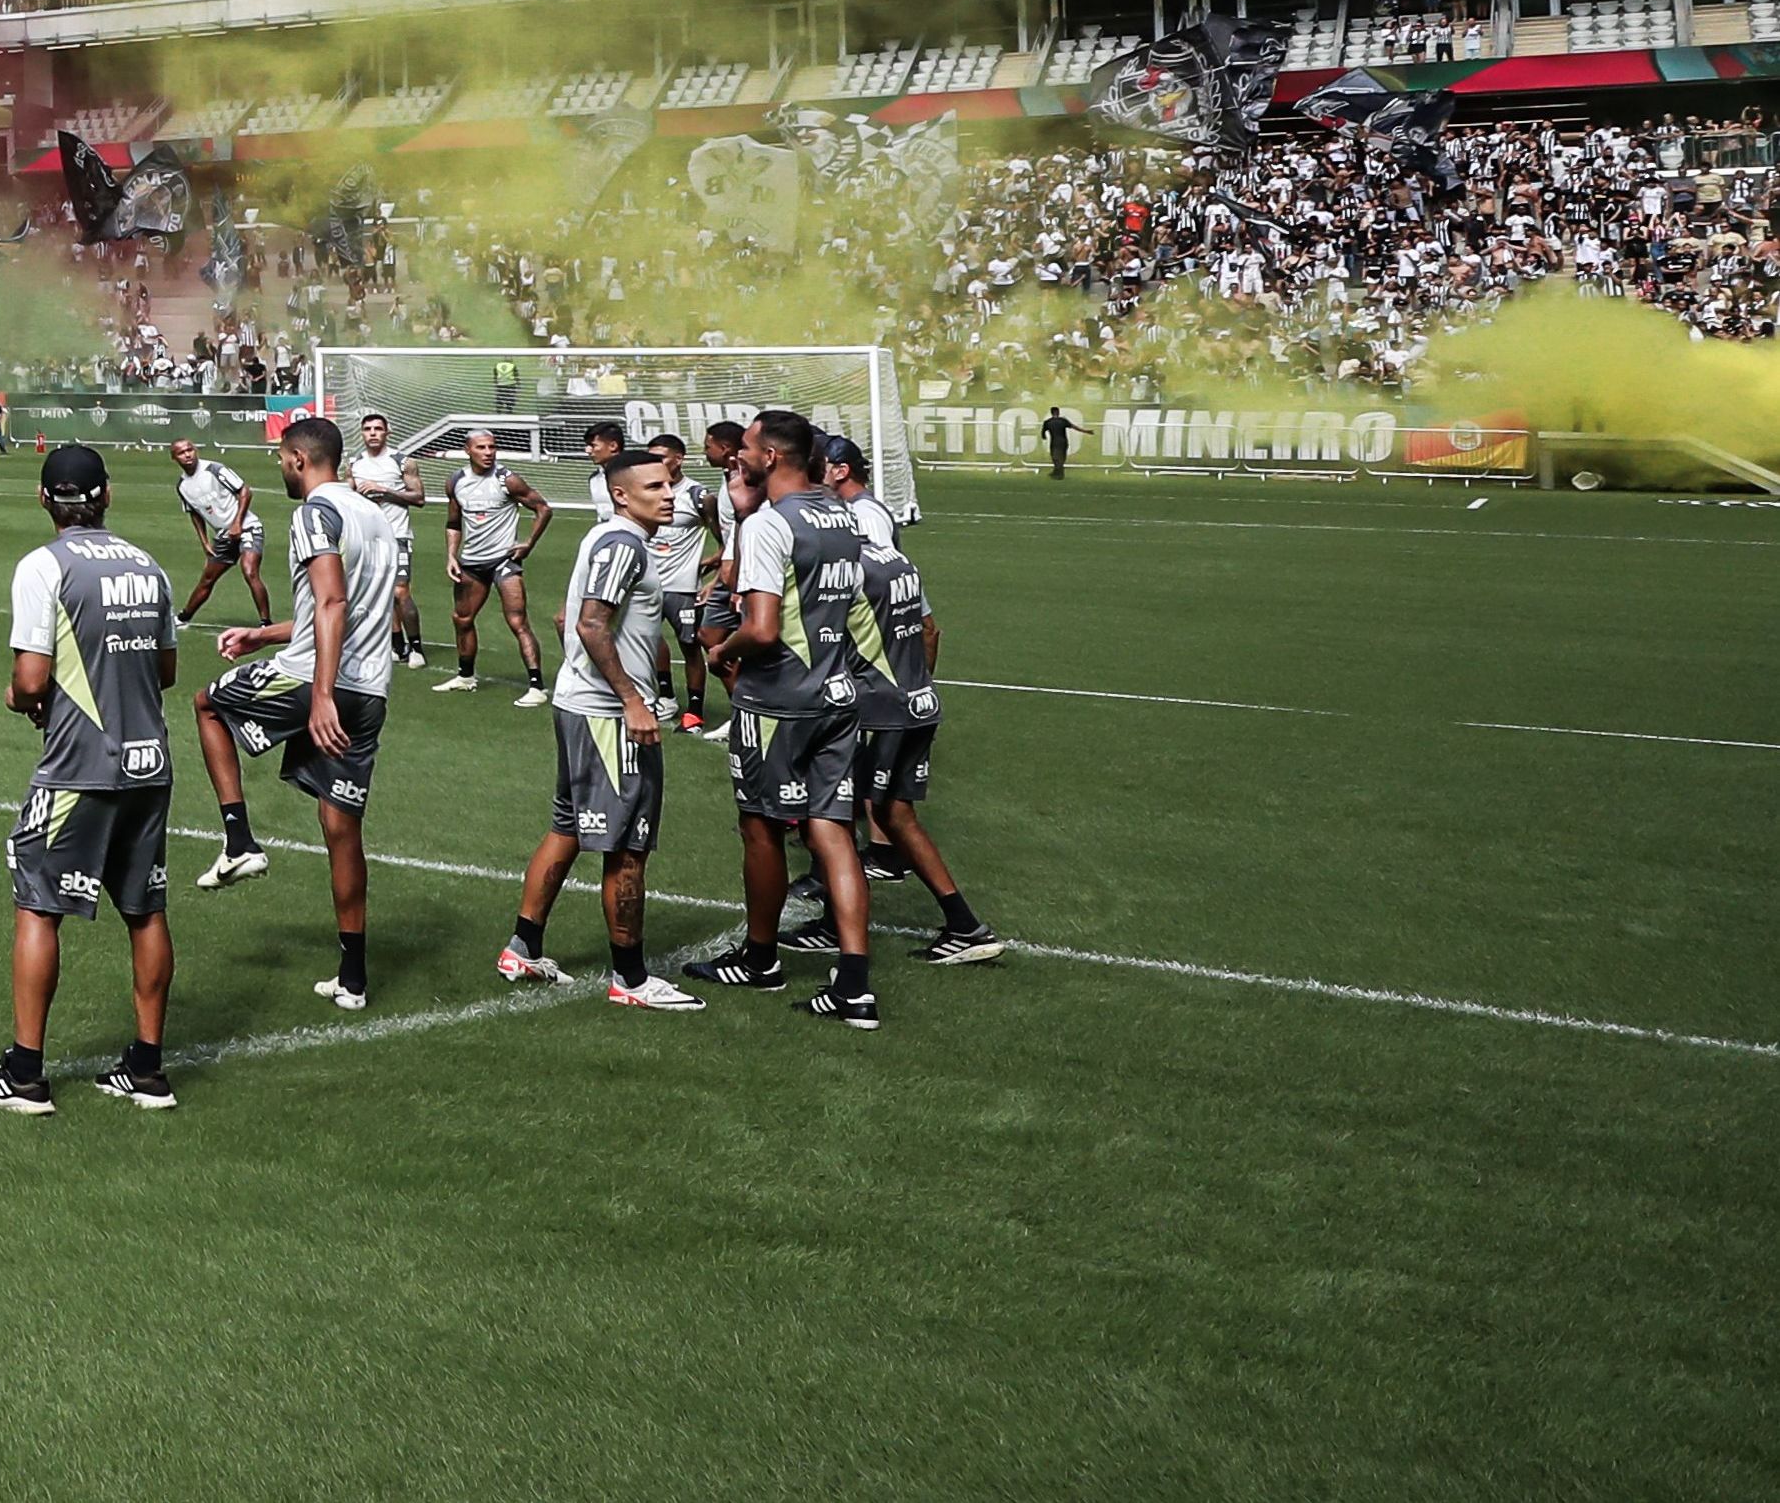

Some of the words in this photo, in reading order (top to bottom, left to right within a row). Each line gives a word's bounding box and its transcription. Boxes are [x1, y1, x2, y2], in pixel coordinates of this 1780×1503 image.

[1101, 407, 1397, 463] MINEIRO
[242, 718, 272, 752] abc
[127, 749, 156, 772] BH
[331, 778, 368, 803] abc
[836, 780, 854, 797] ab
[577, 808, 608, 828] abc
[58, 870, 101, 896] abc
